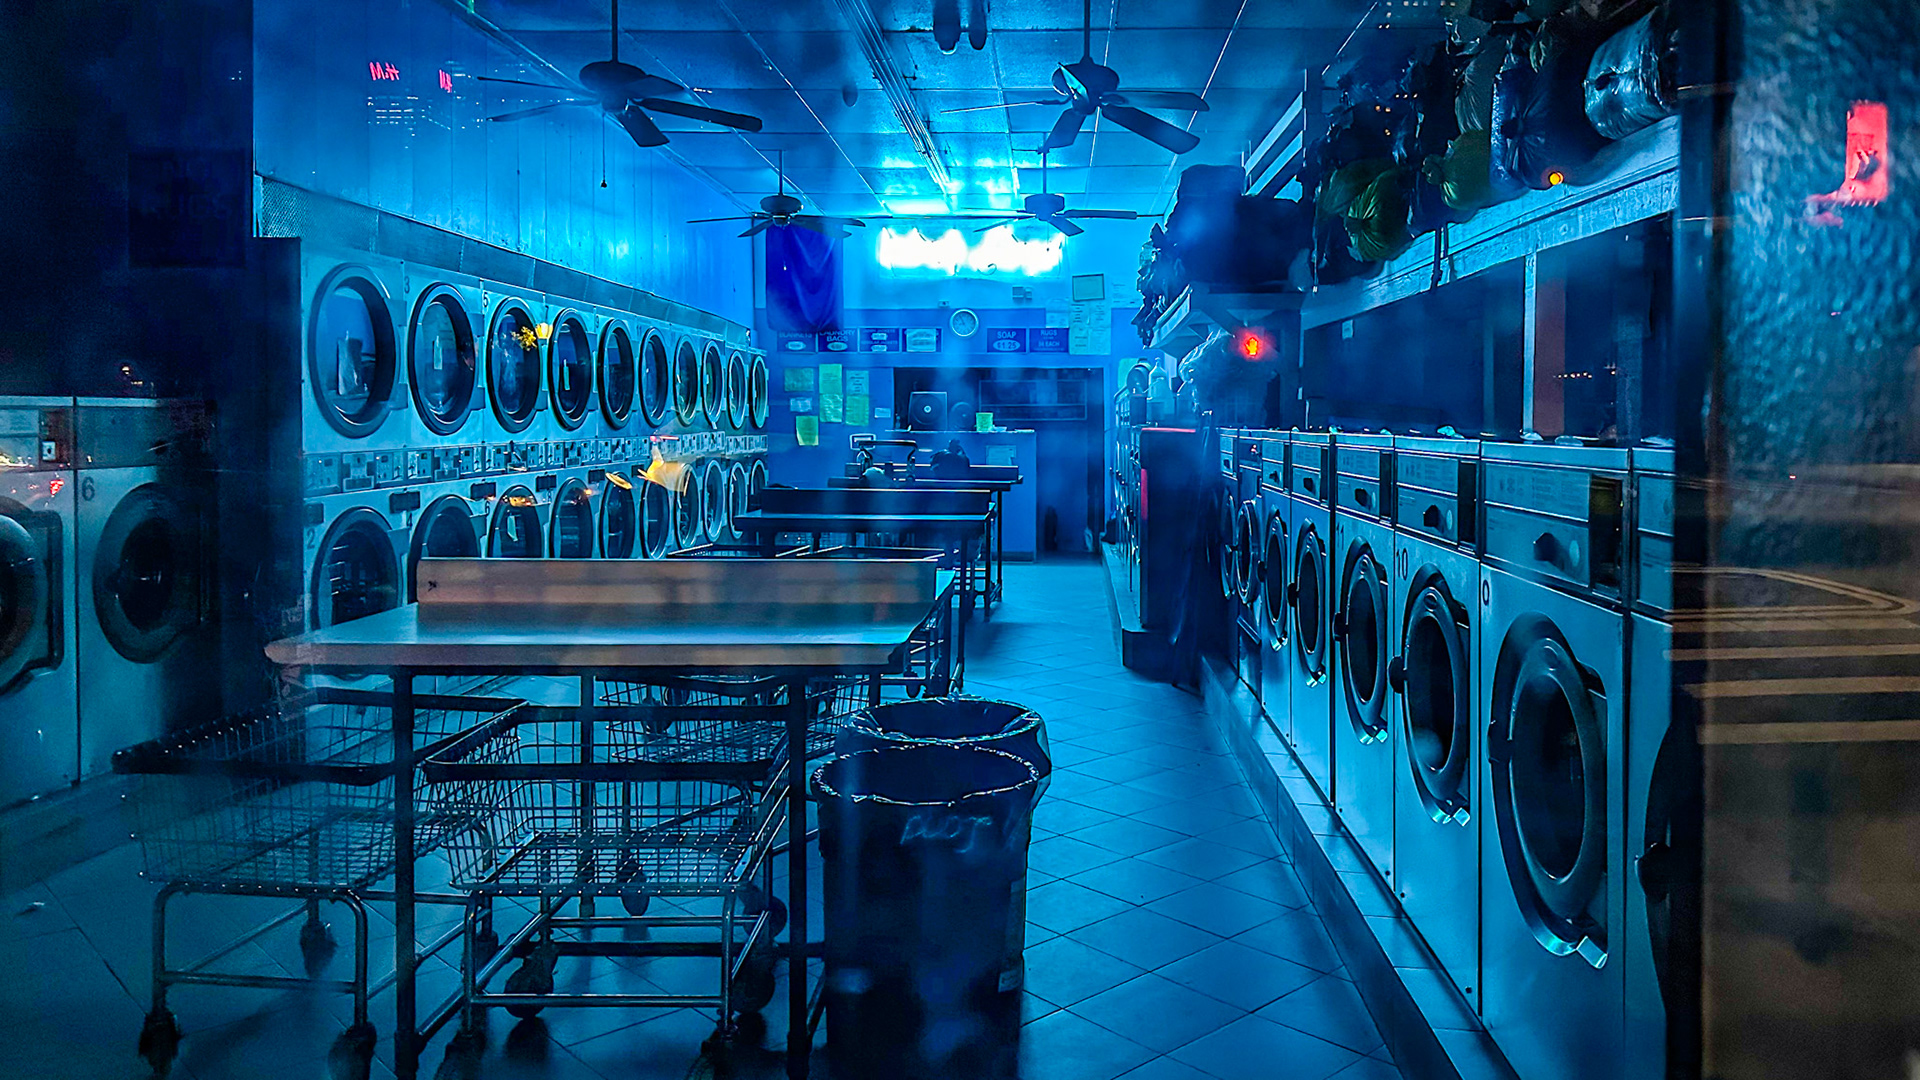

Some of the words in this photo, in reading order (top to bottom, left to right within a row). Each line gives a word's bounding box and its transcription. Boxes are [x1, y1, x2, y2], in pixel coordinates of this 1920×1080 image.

[403, 275, 410, 294] 3
[483, 291, 489, 308] 5
[997, 331, 1016, 339] SOAP
[82, 476, 95, 501] 6
[306, 527, 315, 549] 2
[1396, 547, 1409, 581] 10
